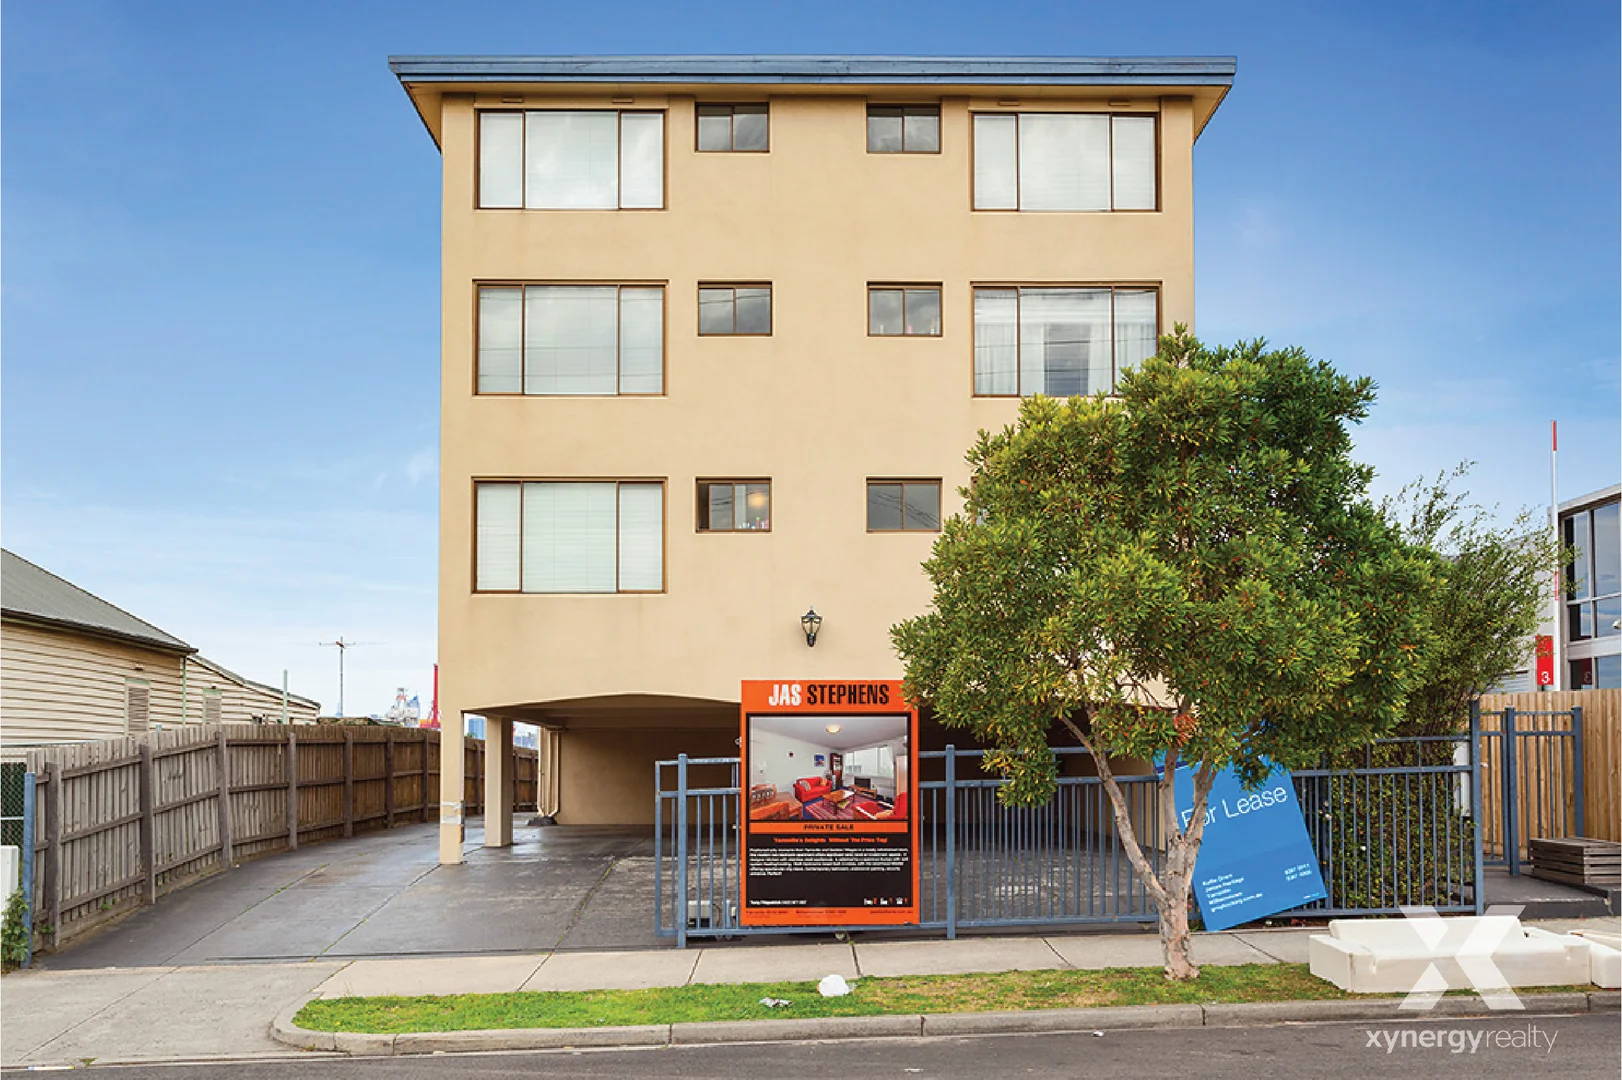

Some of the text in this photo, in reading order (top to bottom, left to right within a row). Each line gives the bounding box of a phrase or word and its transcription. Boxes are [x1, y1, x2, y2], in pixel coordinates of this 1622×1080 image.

[1541, 671, 1550, 684] 3
[768, 684, 890, 706] JAS STEPHENS
[1221, 787, 1288, 819] Lease
